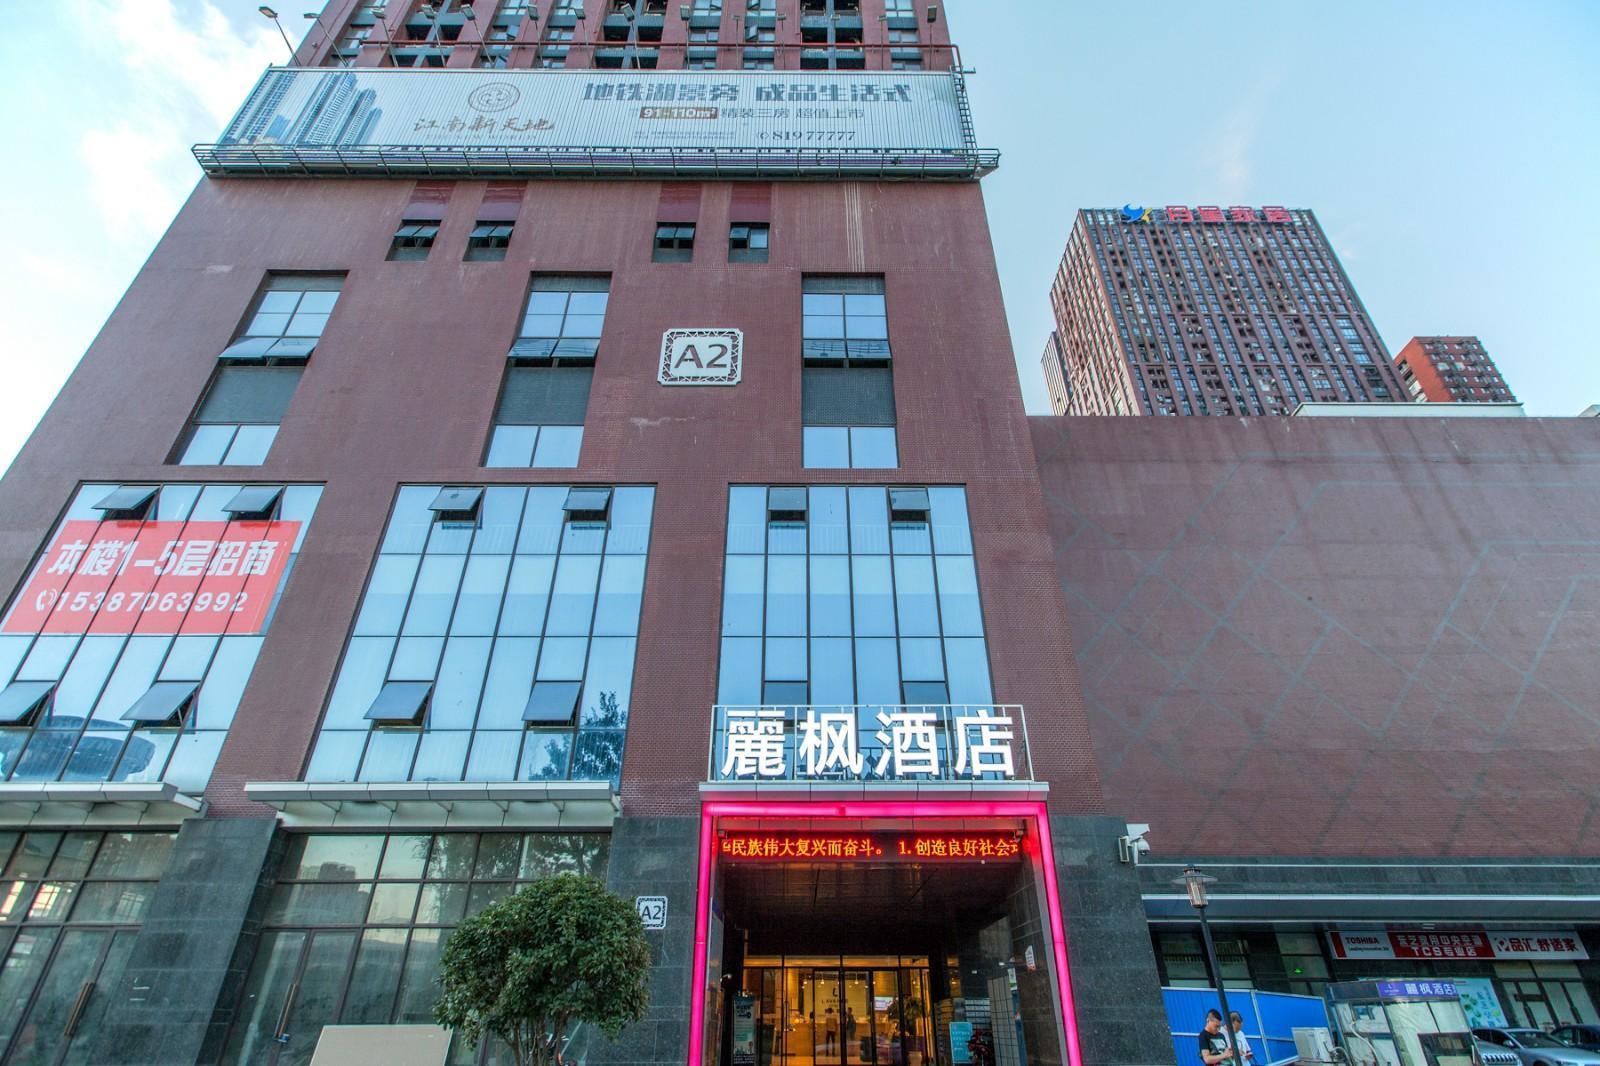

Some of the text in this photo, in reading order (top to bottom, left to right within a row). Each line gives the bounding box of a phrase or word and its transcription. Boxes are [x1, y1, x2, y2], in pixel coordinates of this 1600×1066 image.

[673, 343, 729, 369] A2
[58, 591, 249, 613] 15387063992
[721, 709, 1016, 777] 麗枫酒店
[641, 905, 662, 920] A2
[1345, 936, 1380, 945] TOSHIBA
